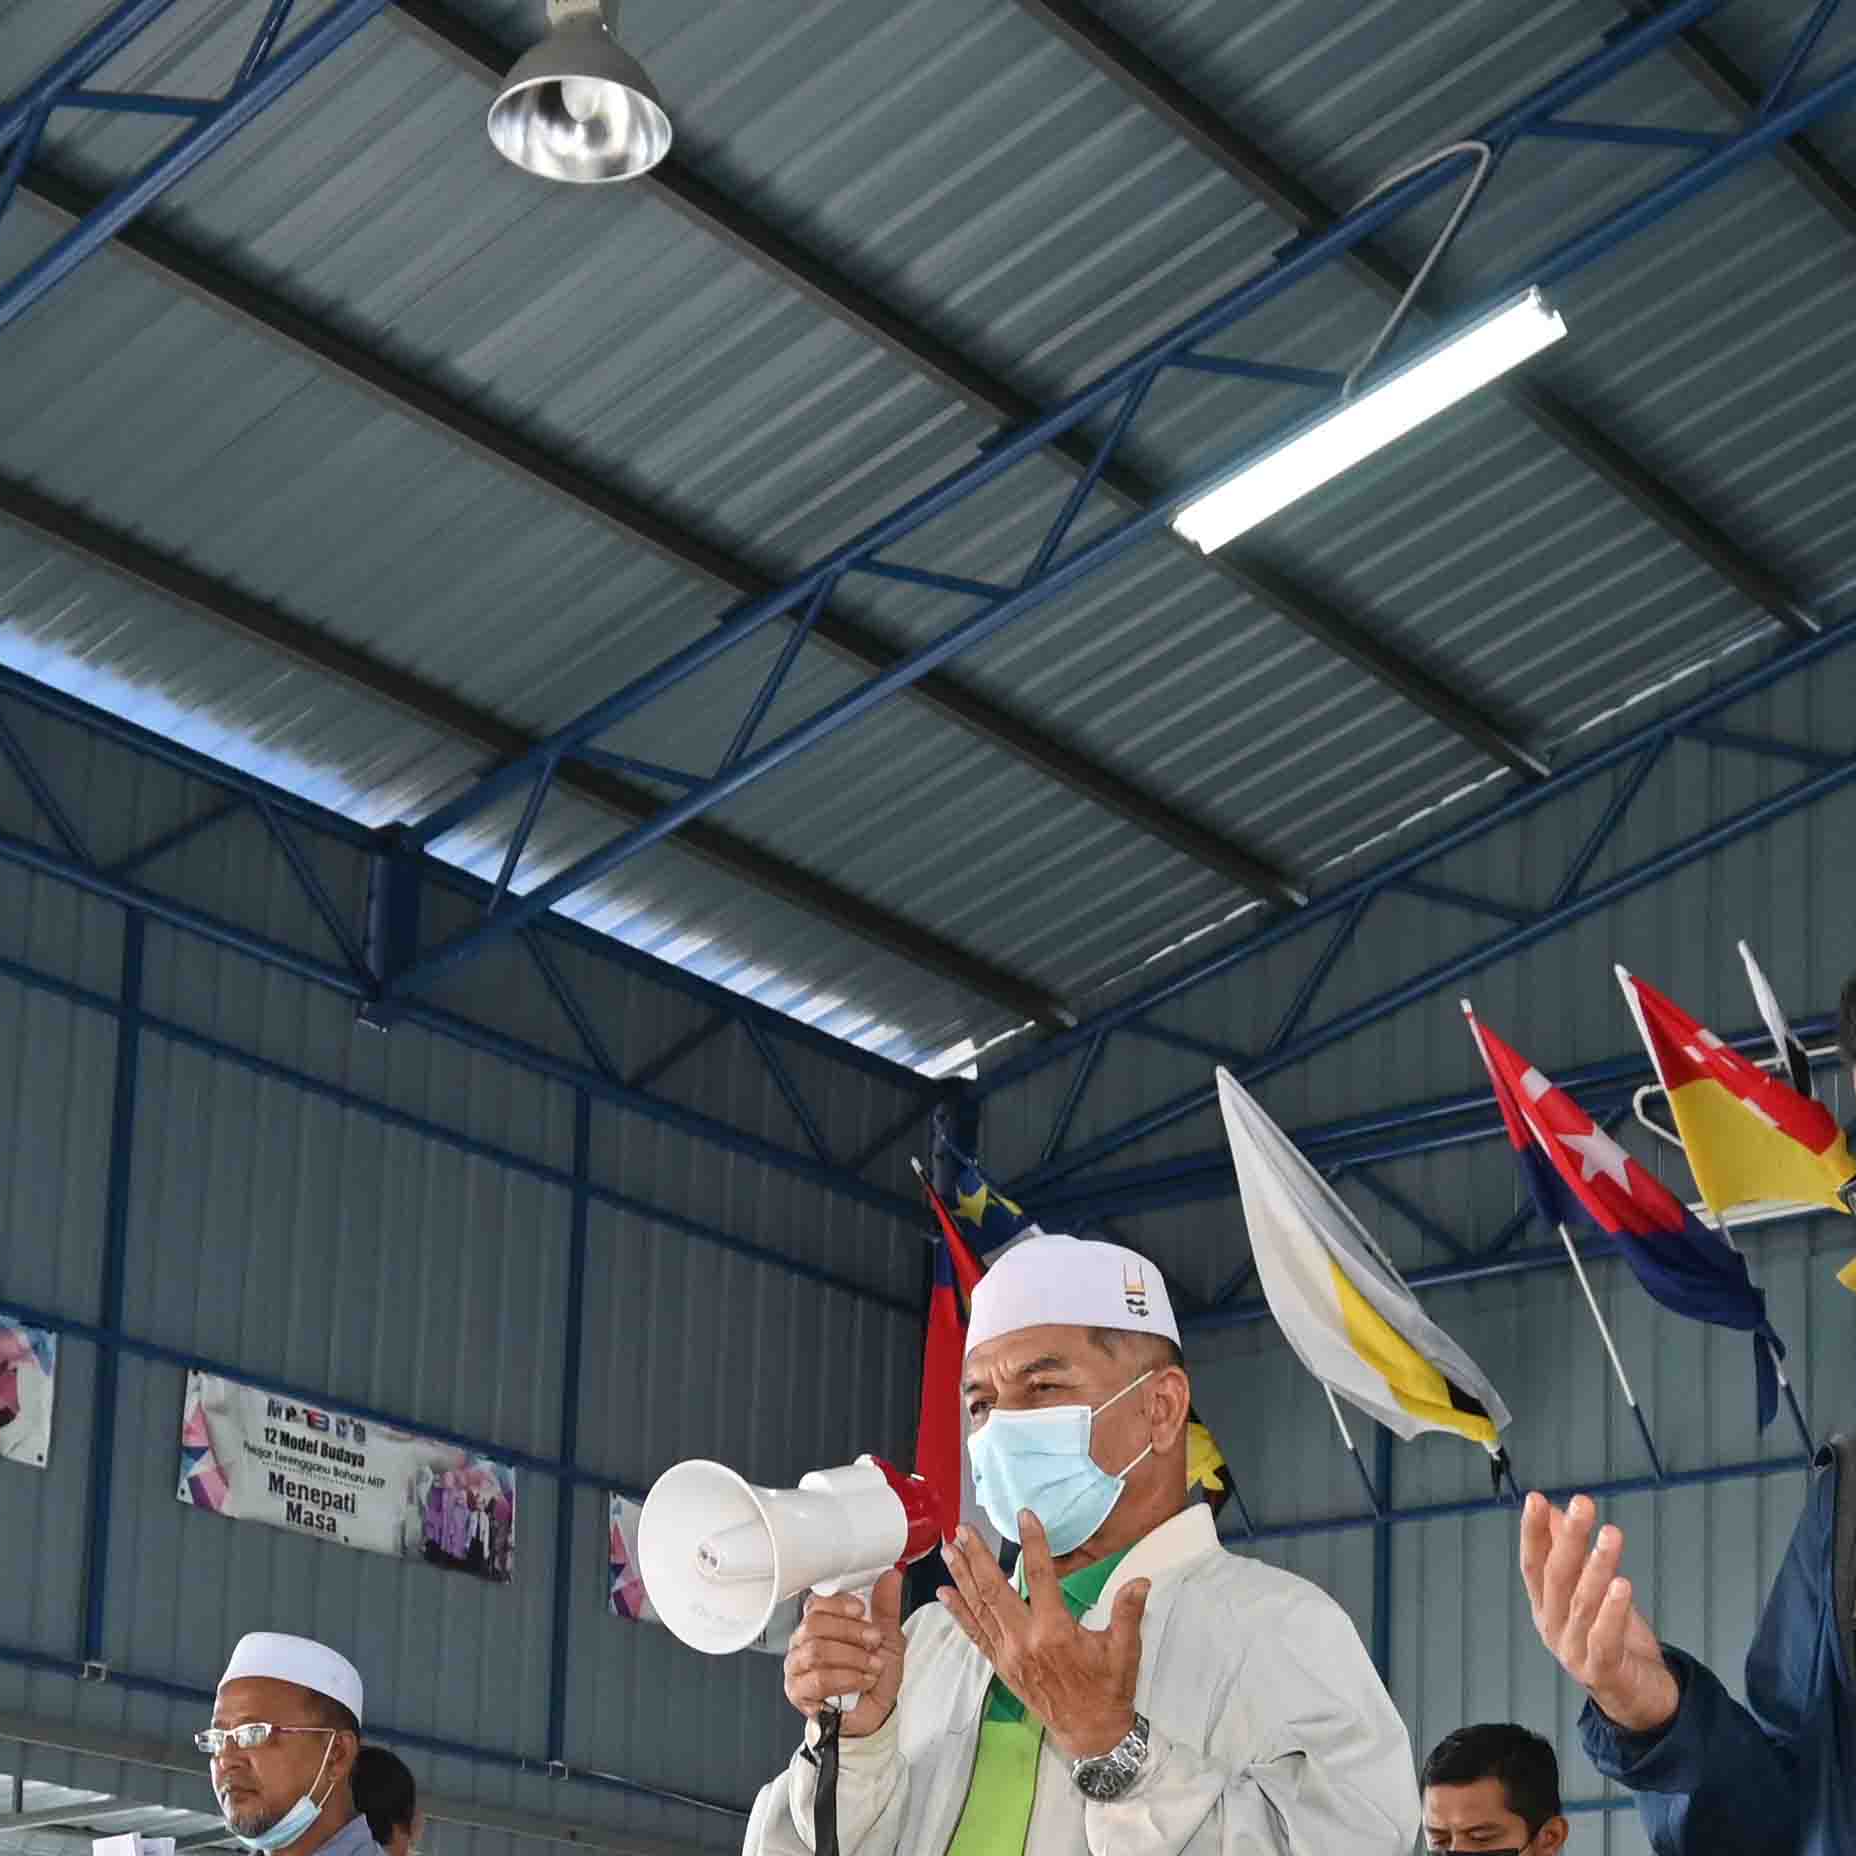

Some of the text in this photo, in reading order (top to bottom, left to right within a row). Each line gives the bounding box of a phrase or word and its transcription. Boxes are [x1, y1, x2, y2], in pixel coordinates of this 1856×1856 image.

[264, 1427, 365, 1468] 12 Model Budaya
[268, 1471, 356, 1514] Menepati
[286, 1501, 336, 1533] Masa
